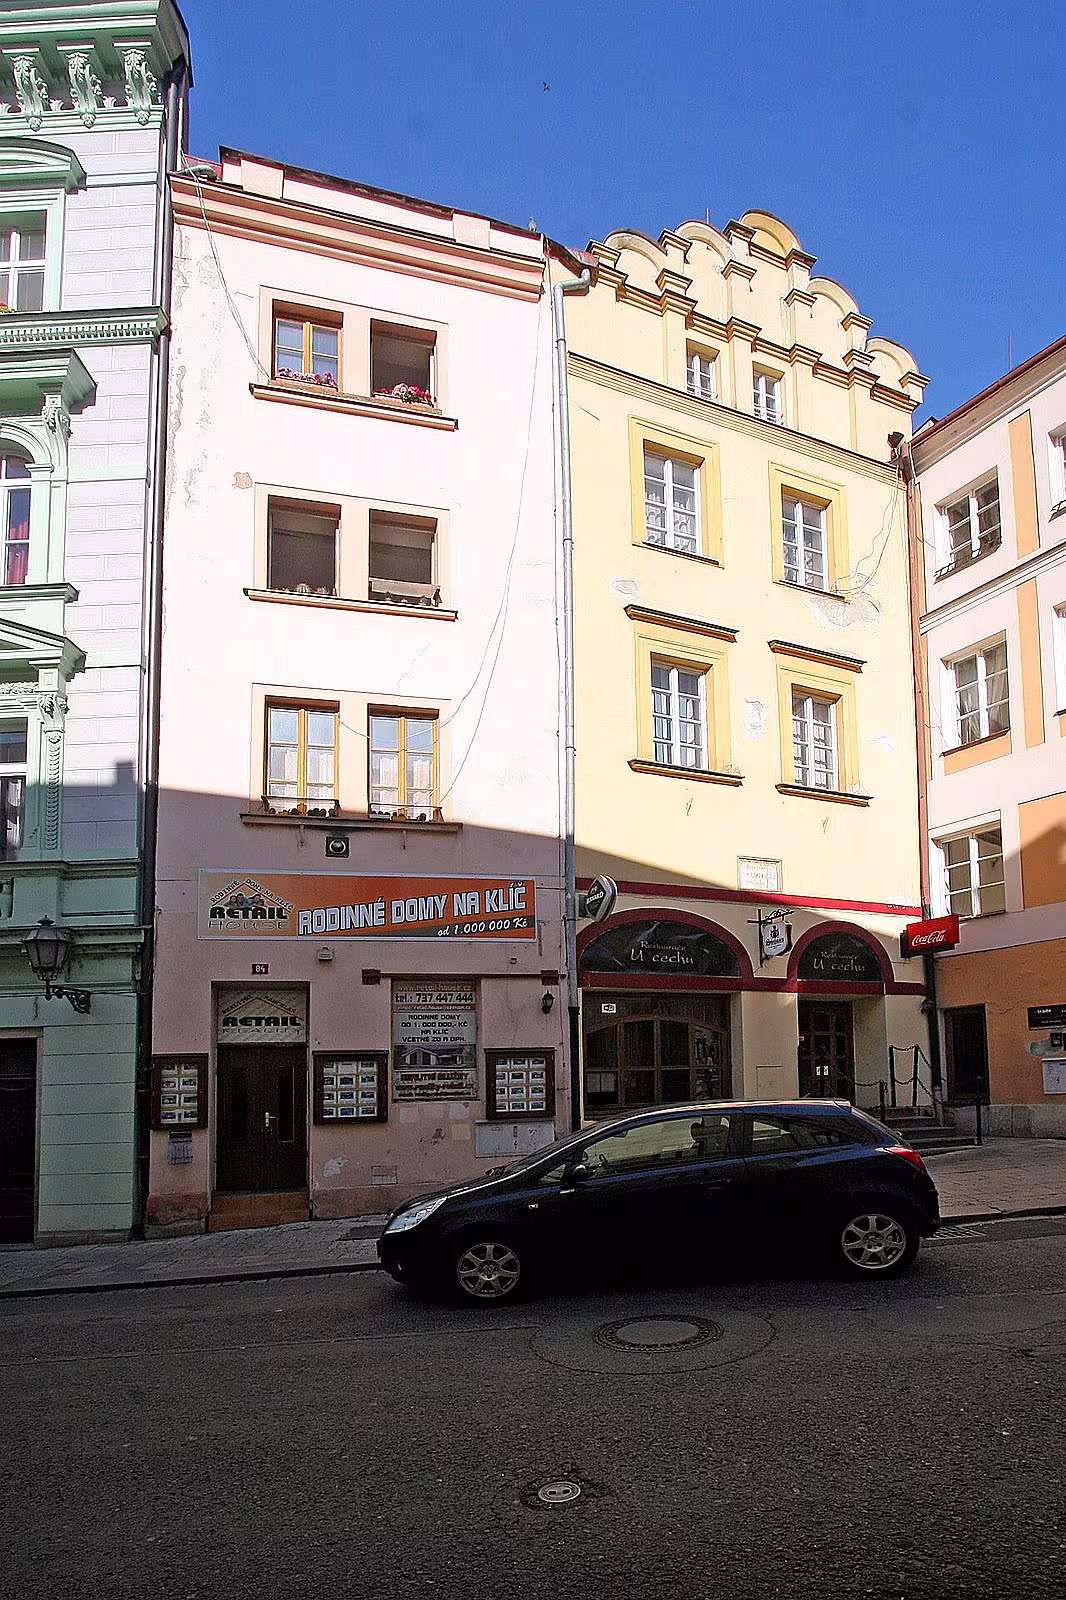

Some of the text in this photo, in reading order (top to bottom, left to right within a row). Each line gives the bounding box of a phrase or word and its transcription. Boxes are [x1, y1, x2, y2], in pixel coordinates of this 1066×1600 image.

[209, 906, 288, 920] RETAIL
[298, 882, 527, 936] RODINNÉ DOMY NA KLÍČ
[208, 920, 290, 930] HOUSE
[437, 927, 450, 936] od
[488, 919, 511, 931] 000
[512, 916, 528, 928] Kč
[630, 948, 644, 962] U
[255, 965, 265, 973] 84
[813, 958, 825, 970] U
[415, 993, 433, 1003] 737
[435, 993, 454, 1003] 447
[455, 993, 474, 1003] 444
[222, 1016, 302, 1027] RETAIL
